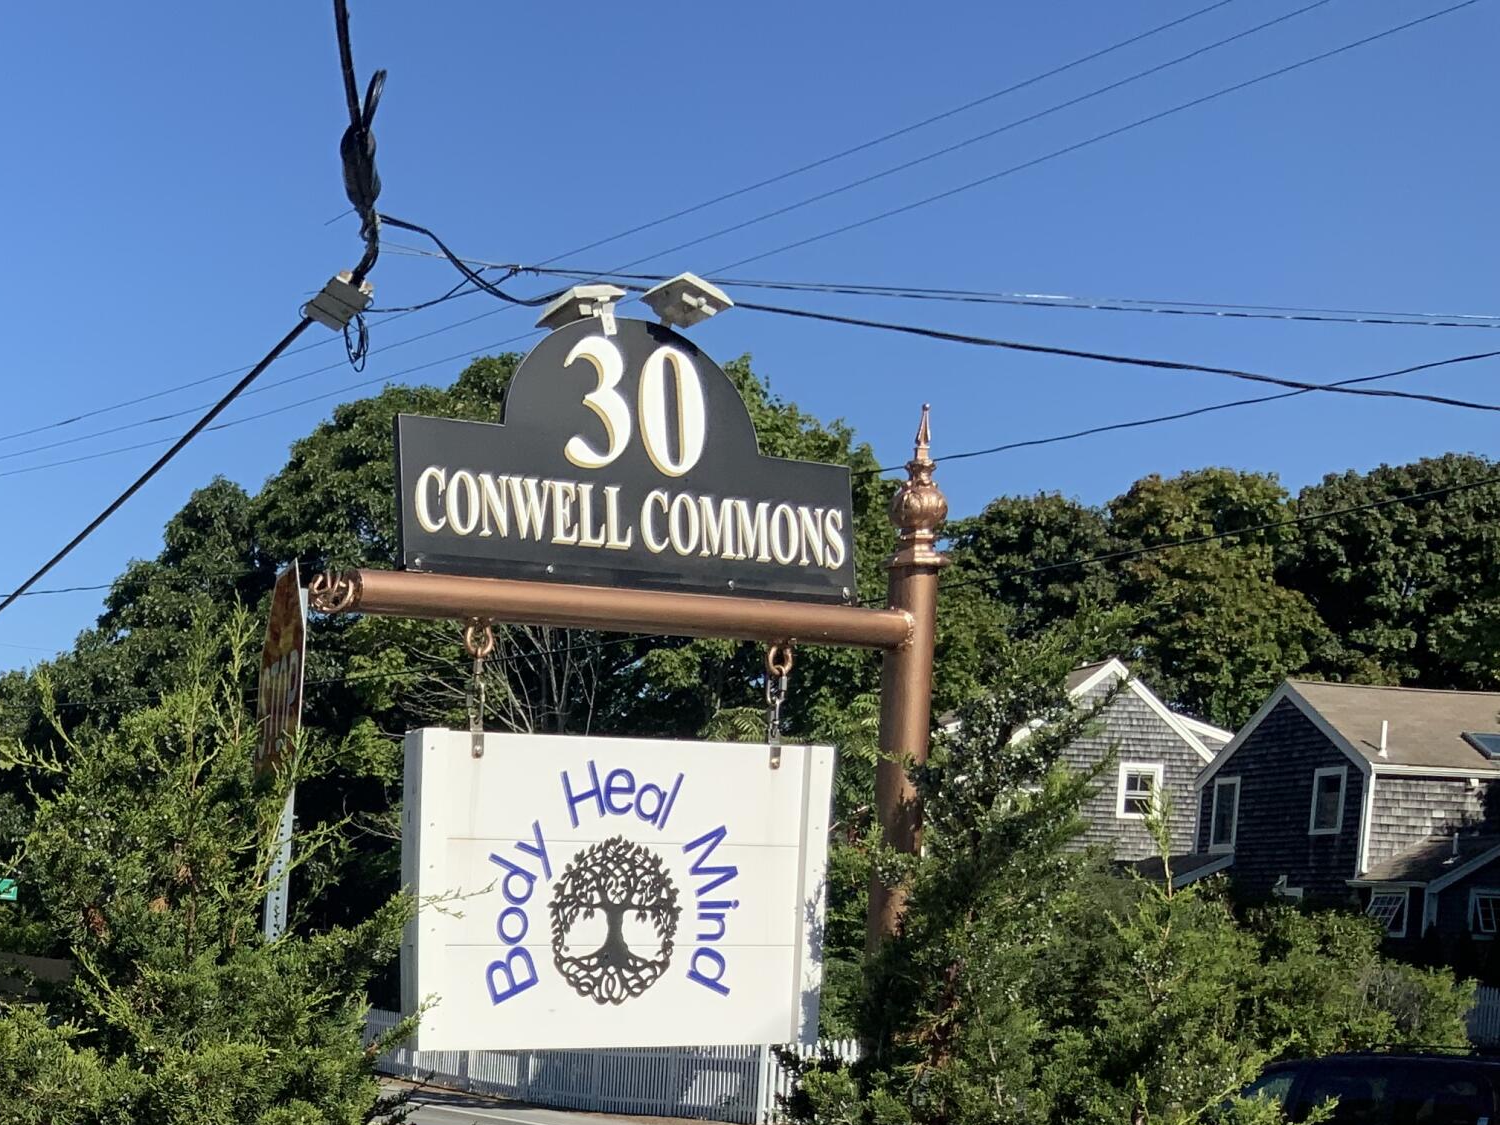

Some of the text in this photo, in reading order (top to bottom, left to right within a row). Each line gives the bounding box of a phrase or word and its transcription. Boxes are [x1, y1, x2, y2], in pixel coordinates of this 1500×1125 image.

[563, 336, 706, 478] 30
[414, 466, 847, 570] CONWELL COMMONS
[485, 760, 740, 1006] Body Heal Mind
